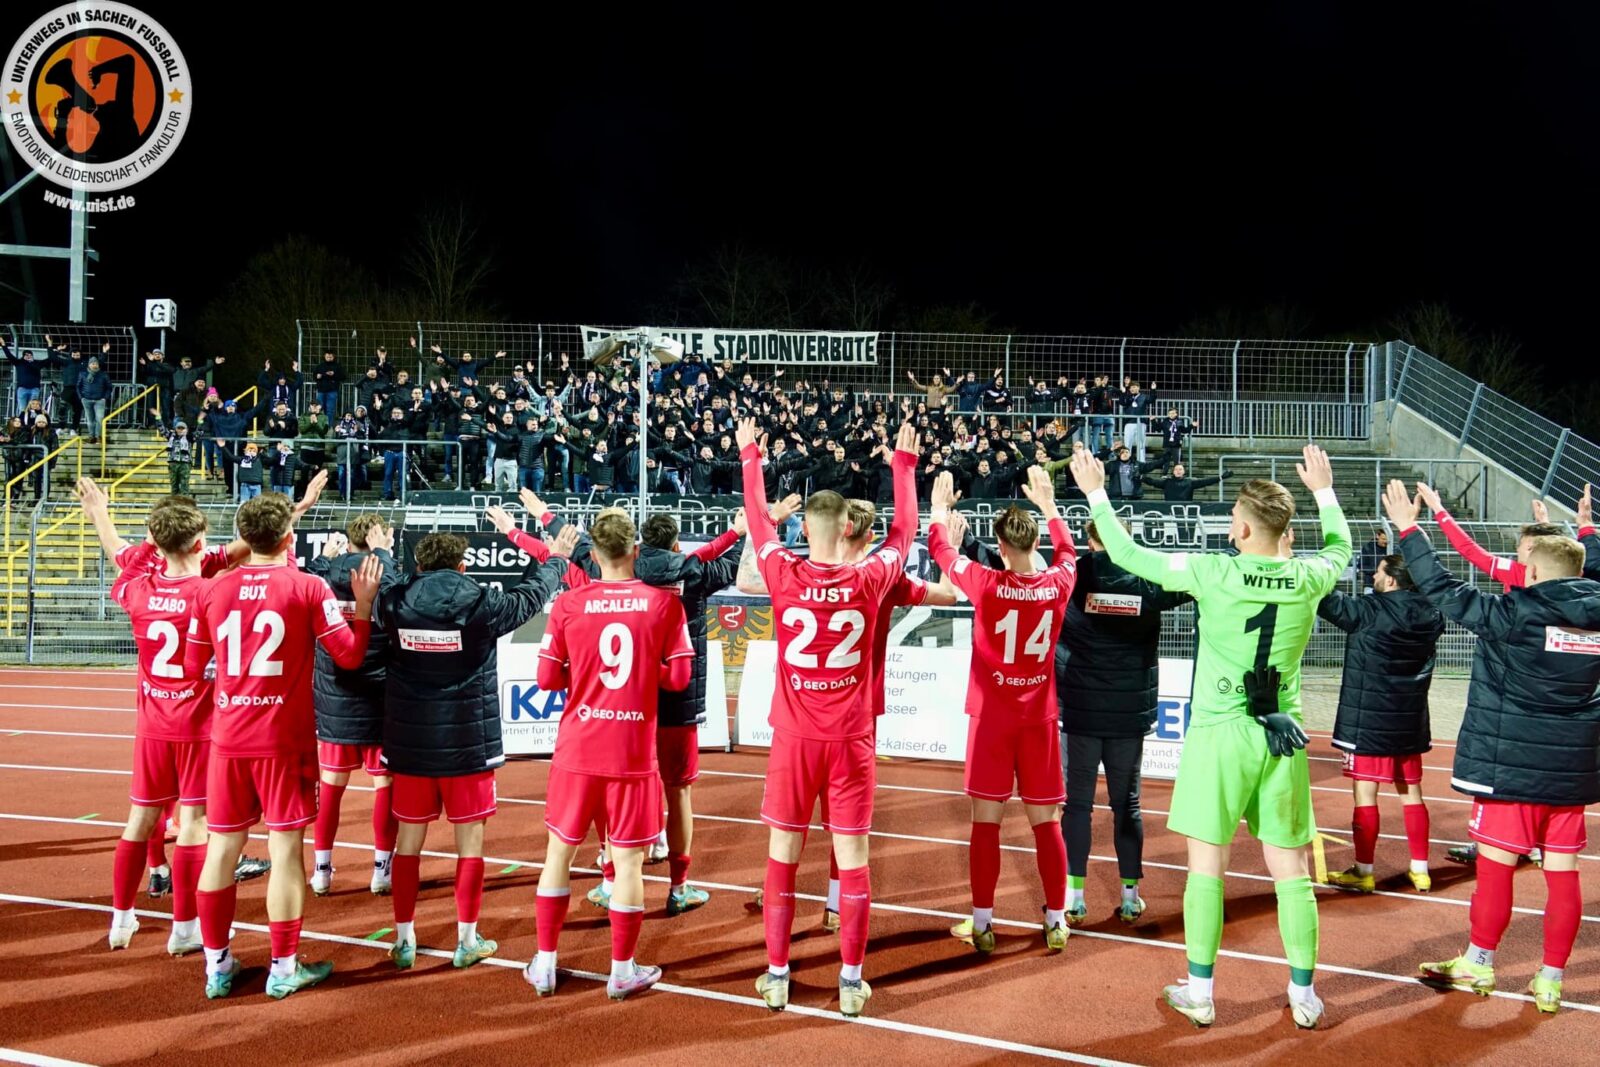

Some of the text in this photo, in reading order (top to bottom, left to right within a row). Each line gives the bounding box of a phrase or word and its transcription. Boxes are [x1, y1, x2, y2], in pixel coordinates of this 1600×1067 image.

[150, 303, 165, 323] G
[713, 333, 876, 362] STADIONVERBOTE
[1244, 573, 1296, 590] WITTE
[239, 585, 267, 600] BUX
[799, 587, 854, 603] JUST
[147, 596, 186, 613] SZABO
[584, 597, 648, 614] ARCALEAN
[1094, 599, 1141, 607] TELENOT
[216, 610, 286, 677] 12
[781, 606, 865, 669] 22
[994, 609, 1054, 664] 14
[1243, 603, 1279, 668] 1
[146, 620, 184, 679] 2
[598, 622, 634, 690] 9
[803, 675, 858, 691] GEO DATA
[1006, 675, 1047, 687] GEO DATA
[150, 688, 169, 699] GEO
[231, 694, 284, 706] GEO DATA
[591, 708, 645, 721] GEO DATA
